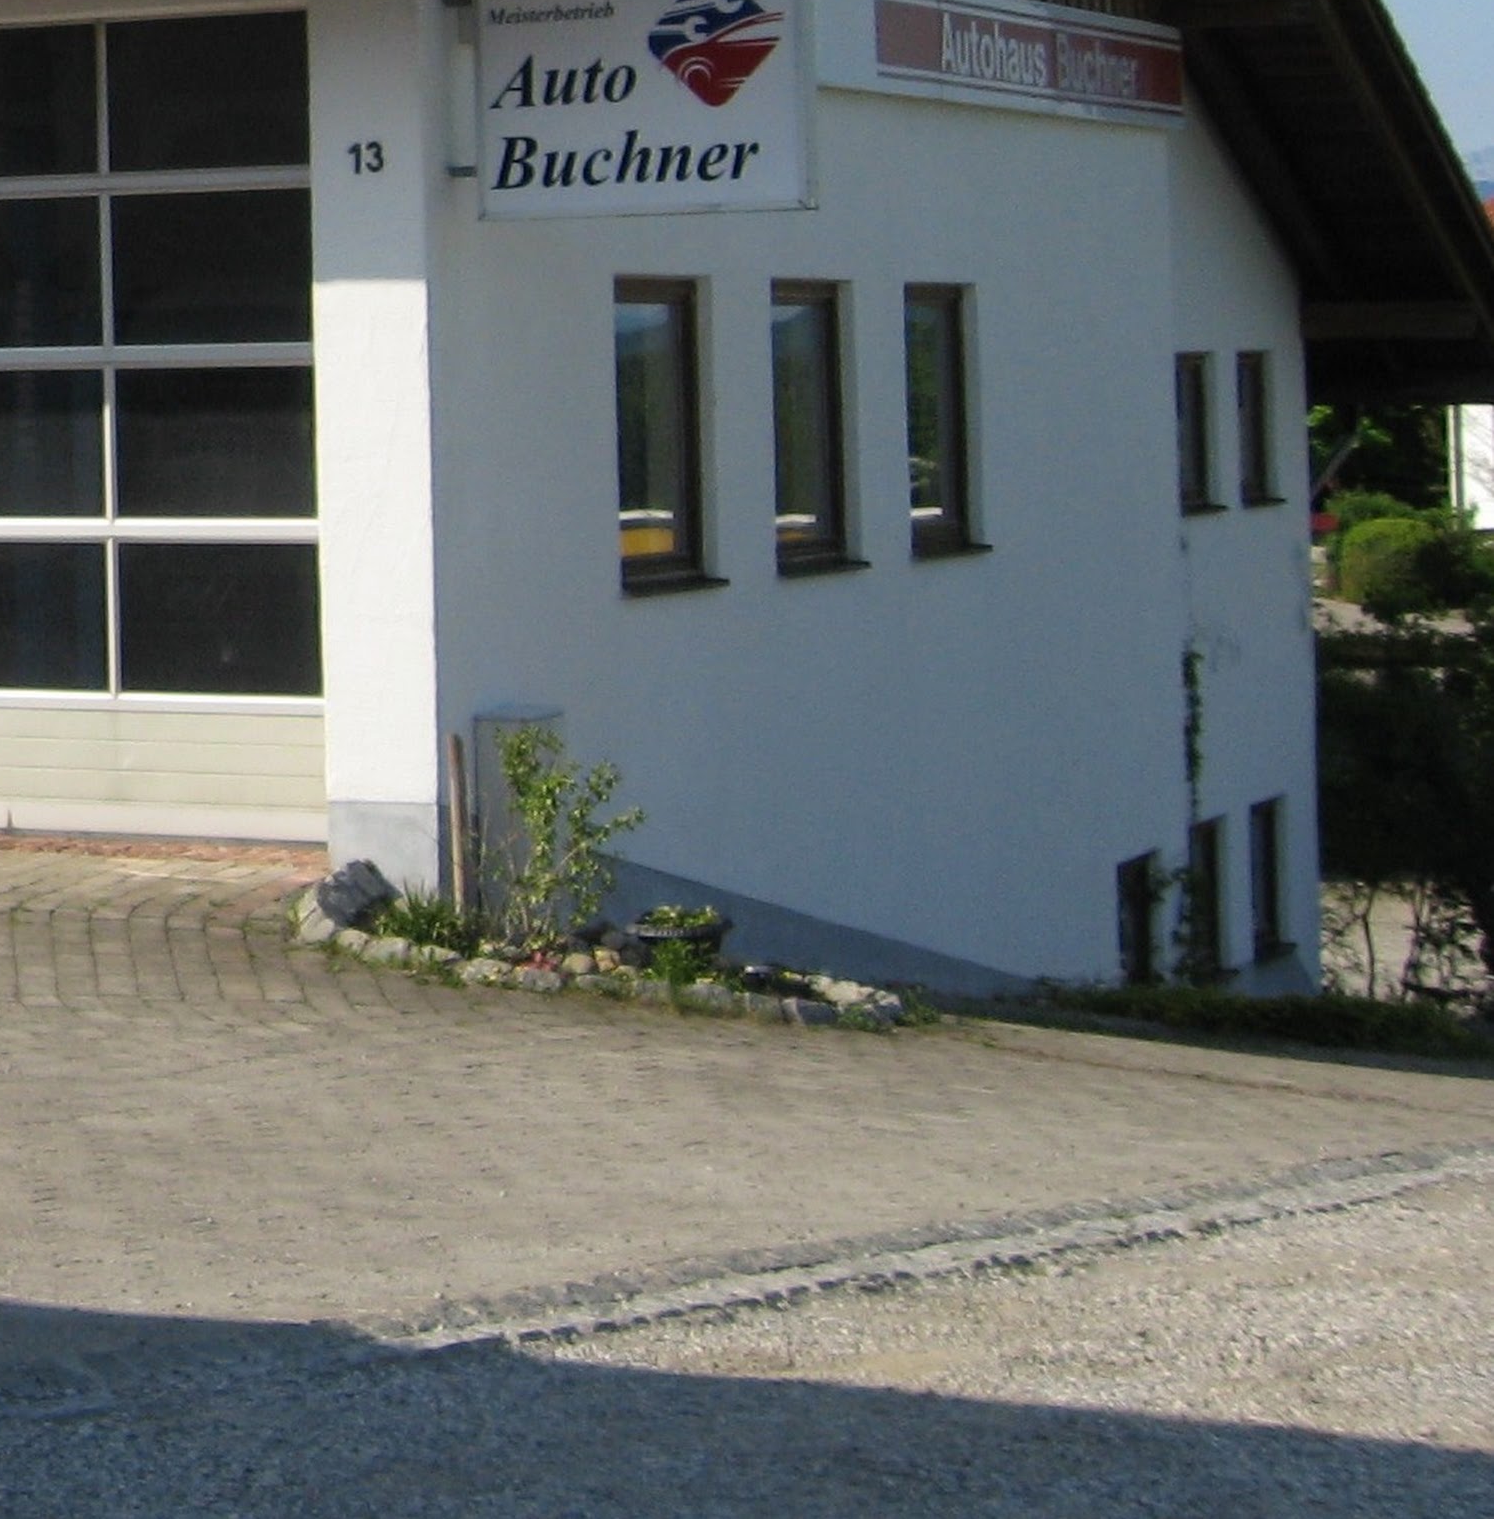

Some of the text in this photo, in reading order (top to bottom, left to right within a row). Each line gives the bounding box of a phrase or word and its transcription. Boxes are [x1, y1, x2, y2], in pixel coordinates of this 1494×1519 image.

[489, 0, 615, 25] Meisterbetrieb
[942, 11, 1048, 88] Autohaus
[490, 53, 638, 109] Auto
[347, 141, 385, 175] 13
[491, 128, 760, 190] Buchner
